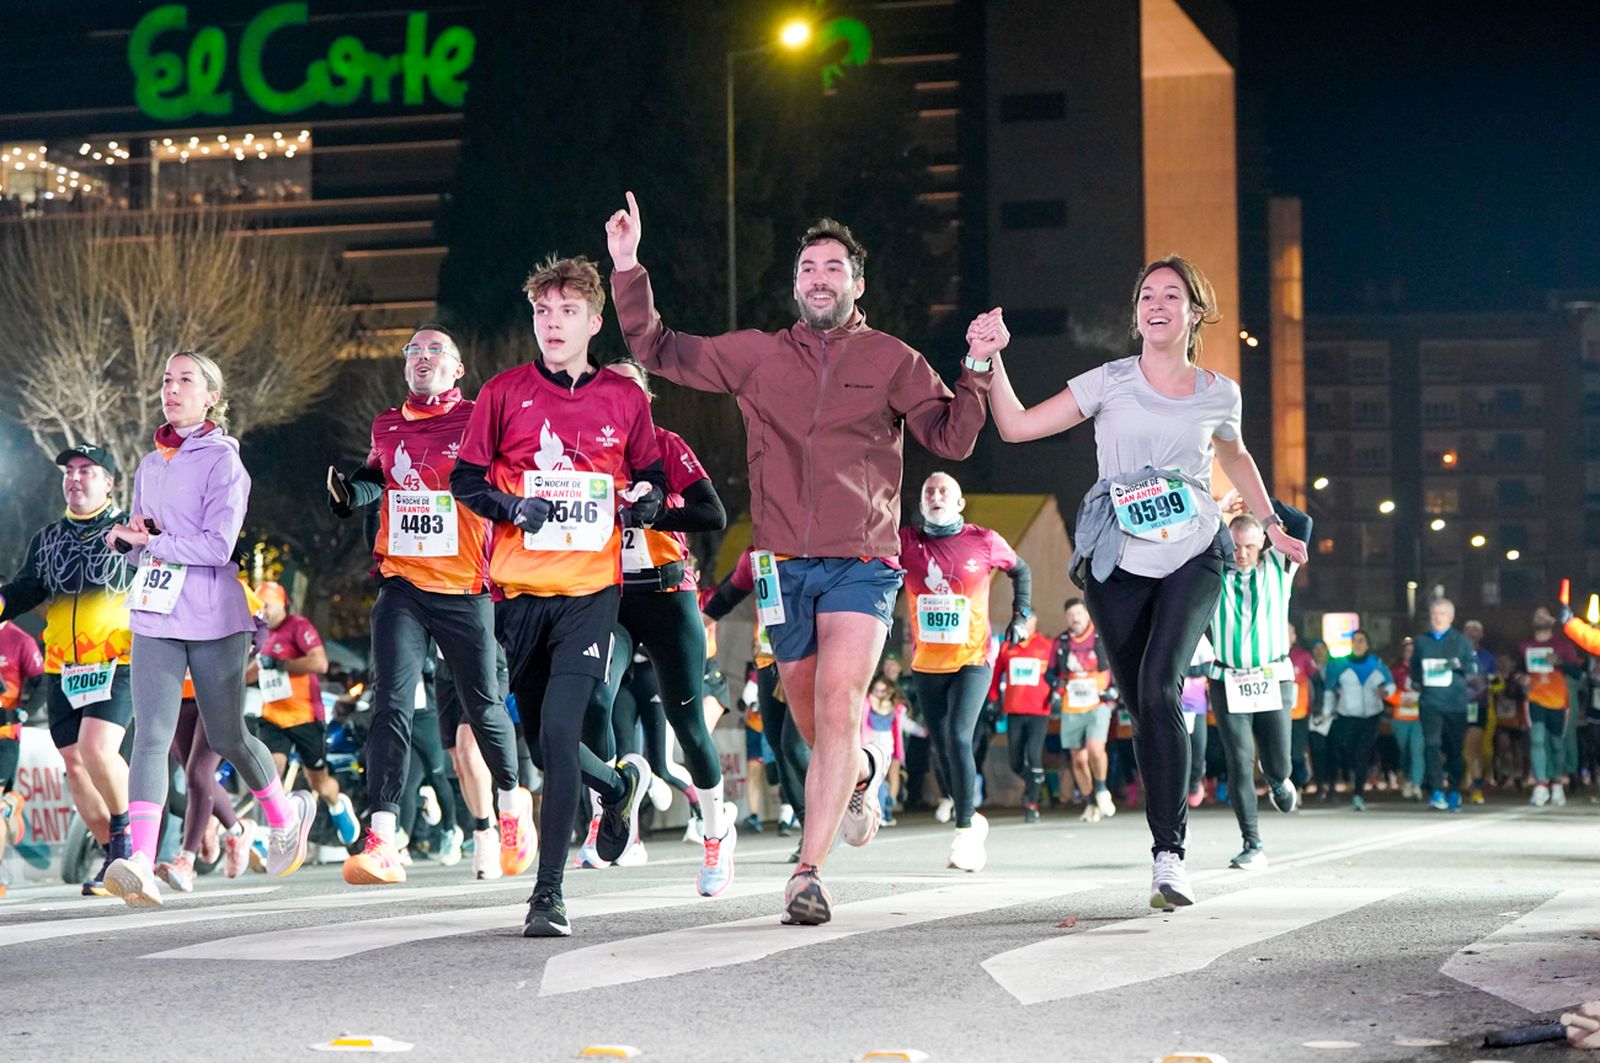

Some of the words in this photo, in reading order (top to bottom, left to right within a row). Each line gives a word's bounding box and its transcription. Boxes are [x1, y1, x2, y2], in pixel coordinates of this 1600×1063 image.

[129, 3, 233, 121] El
[239, 1, 476, 113] Corte
[403, 474, 420, 491] 43
[544, 480, 569, 488] NOCHE
[1124, 480, 1148, 494] NOCHE
[1150, 476, 1160, 486] DE
[534, 489, 551, 498] SAN
[1118, 494, 1135, 505] SAN
[1128, 491, 1185, 526] 8599
[401, 514, 443, 534] 4483
[621, 530, 635, 549] 2
[144, 568, 172, 590] 92
[756, 577, 768, 600] 0
[927, 612, 959, 627] 8978
[67, 671, 108, 692] 12005
[1238, 681, 1270, 697] 1932
[18, 767, 61, 801] SAN
[32, 807, 71, 842] ANT
